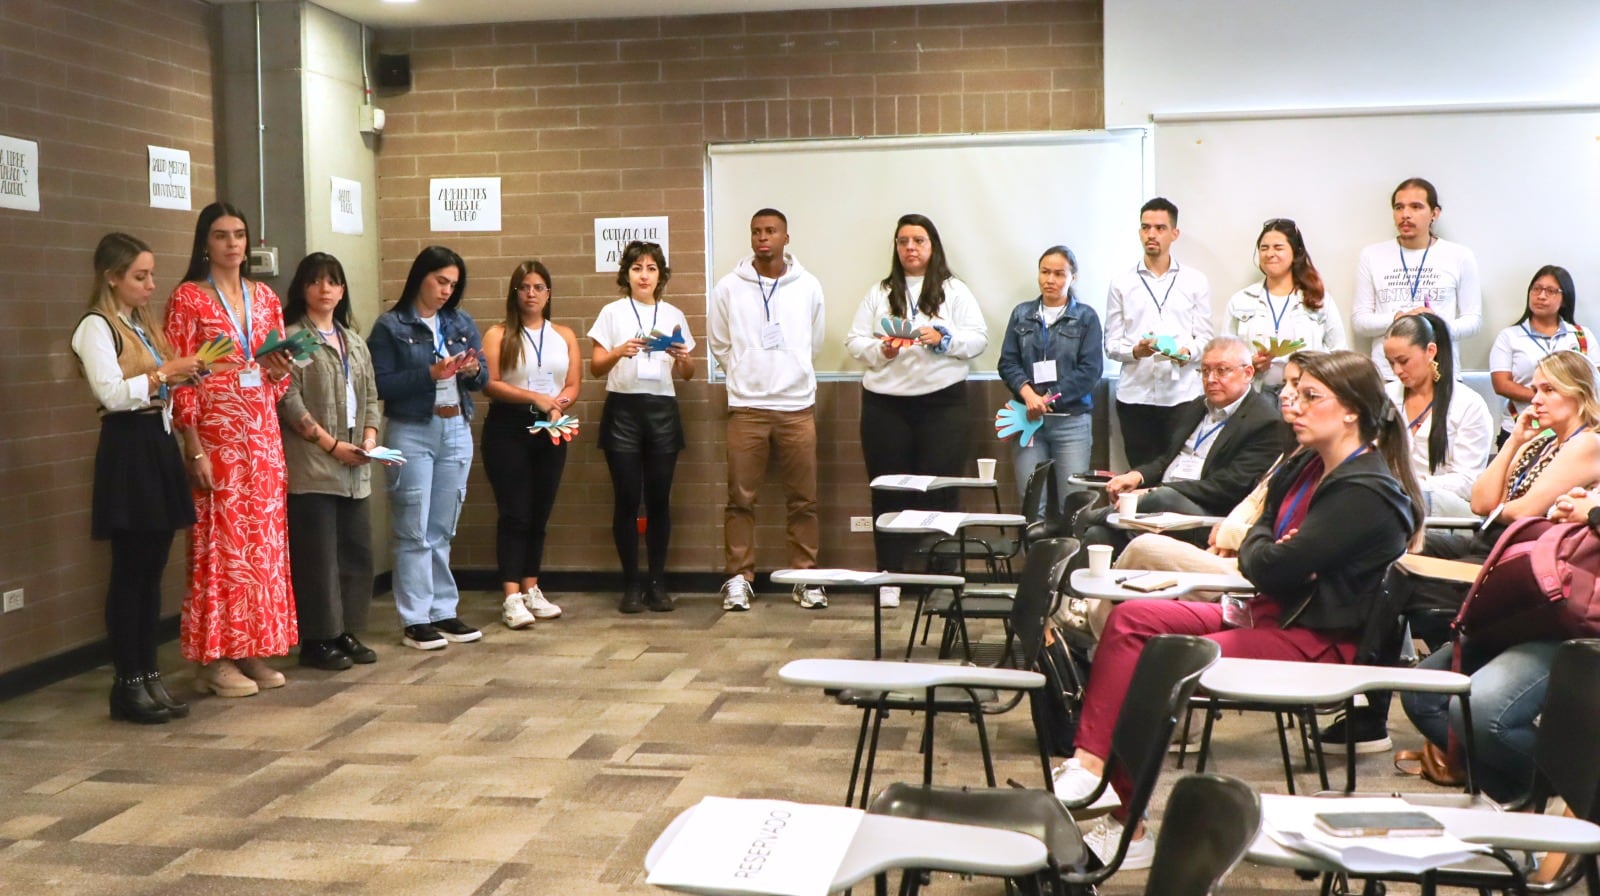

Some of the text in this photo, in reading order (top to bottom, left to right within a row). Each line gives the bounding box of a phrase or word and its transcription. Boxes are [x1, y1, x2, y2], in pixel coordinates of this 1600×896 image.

[438, 187, 487, 201] AMBIENTES
[602, 227, 640, 241] CUIDADO
[1384, 273, 1440, 281] and fanastic
[1388, 279, 1410, 287] mind
[1422, 279, 1437, 287] the
[734, 810, 792, 878] RESERVADO
